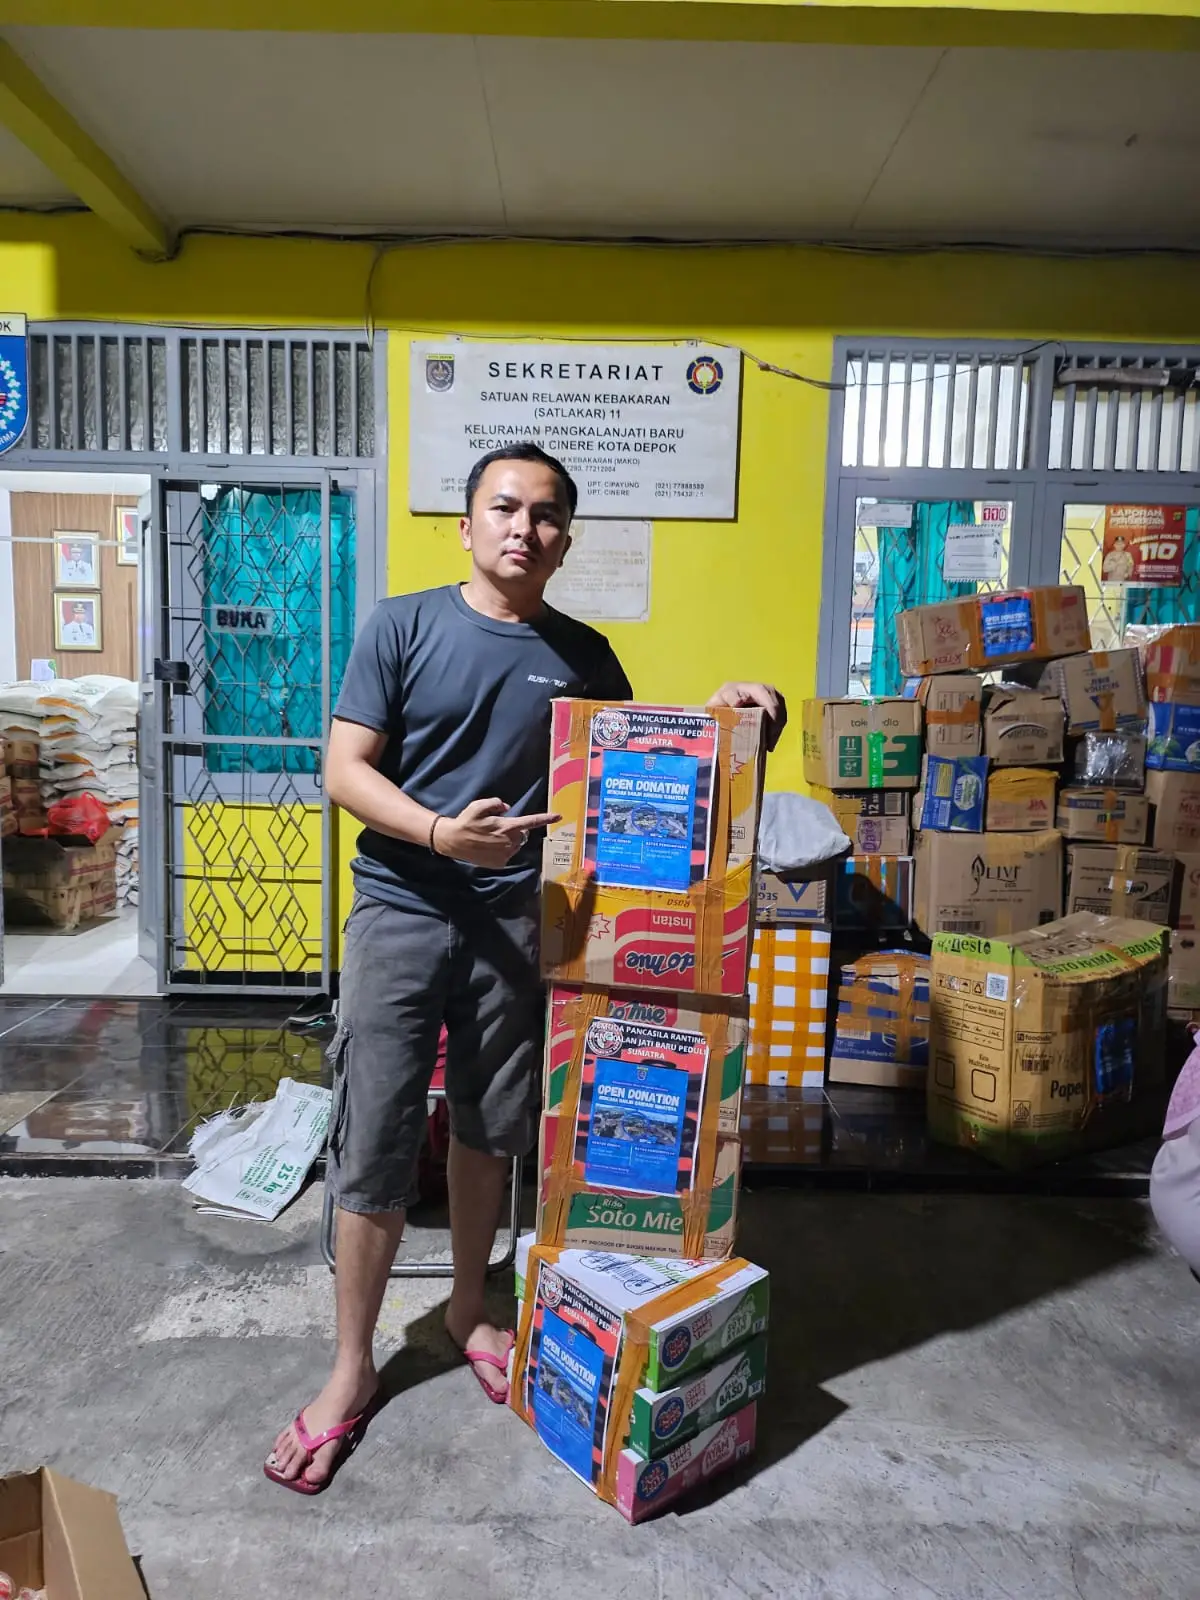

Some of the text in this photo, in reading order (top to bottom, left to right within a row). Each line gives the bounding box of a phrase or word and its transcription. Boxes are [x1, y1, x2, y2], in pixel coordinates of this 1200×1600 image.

[488, 361, 665, 382] SEKRETARIAT
[480, 391, 671, 405] SATUAN RELAWAN KEBAKARAN
[534, 407, 621, 420] (SATLAKAR) 11
[464, 424, 685, 439] KELURAHAN PANGKALANJATI BARU
[549, 440, 594, 451] CINERE
[597, 440, 630, 452] KOTA
[634, 441, 677, 453] DEPOK
[604, 481, 640, 489] CIPAYUNG
[983, 508, 1007, 520] 110
[1140, 542, 1178, 561] 110
[217, 609, 265, 628] BUKA
[632, 714, 676, 724] PANCASILA
[678, 718, 715, 727] RANTING
[644, 726, 661, 735] JATI
[663, 728, 685, 736] BARU
[634, 737, 673, 747] SUMATRA
[605, 777, 690, 796] OPEN DONATION
[666, 898, 691, 908] Rasa
[652, 915, 692, 930] Instan
[1078, 952, 1117, 969] PRIMA
[626, 1027, 669, 1040] PANCASILA
[670, 1033, 706, 1044] RANTING
[638, 1037, 654, 1047] JATI
[655, 1041, 677, 1051] BARU
[627, 1047, 665, 1060] SUMATRA
[598, 1084, 680, 1106] OPEN DONATION
[263, 1162, 294, 1193] 25 kg
[586, 1205, 684, 1231] Soto Mie
[564, 1281, 594, 1308] PANCASILA
[543, 1334, 561, 1358] OPEN
[560, 1349, 596, 1385] DONATION
[719, 1383, 743, 1406] BASO
